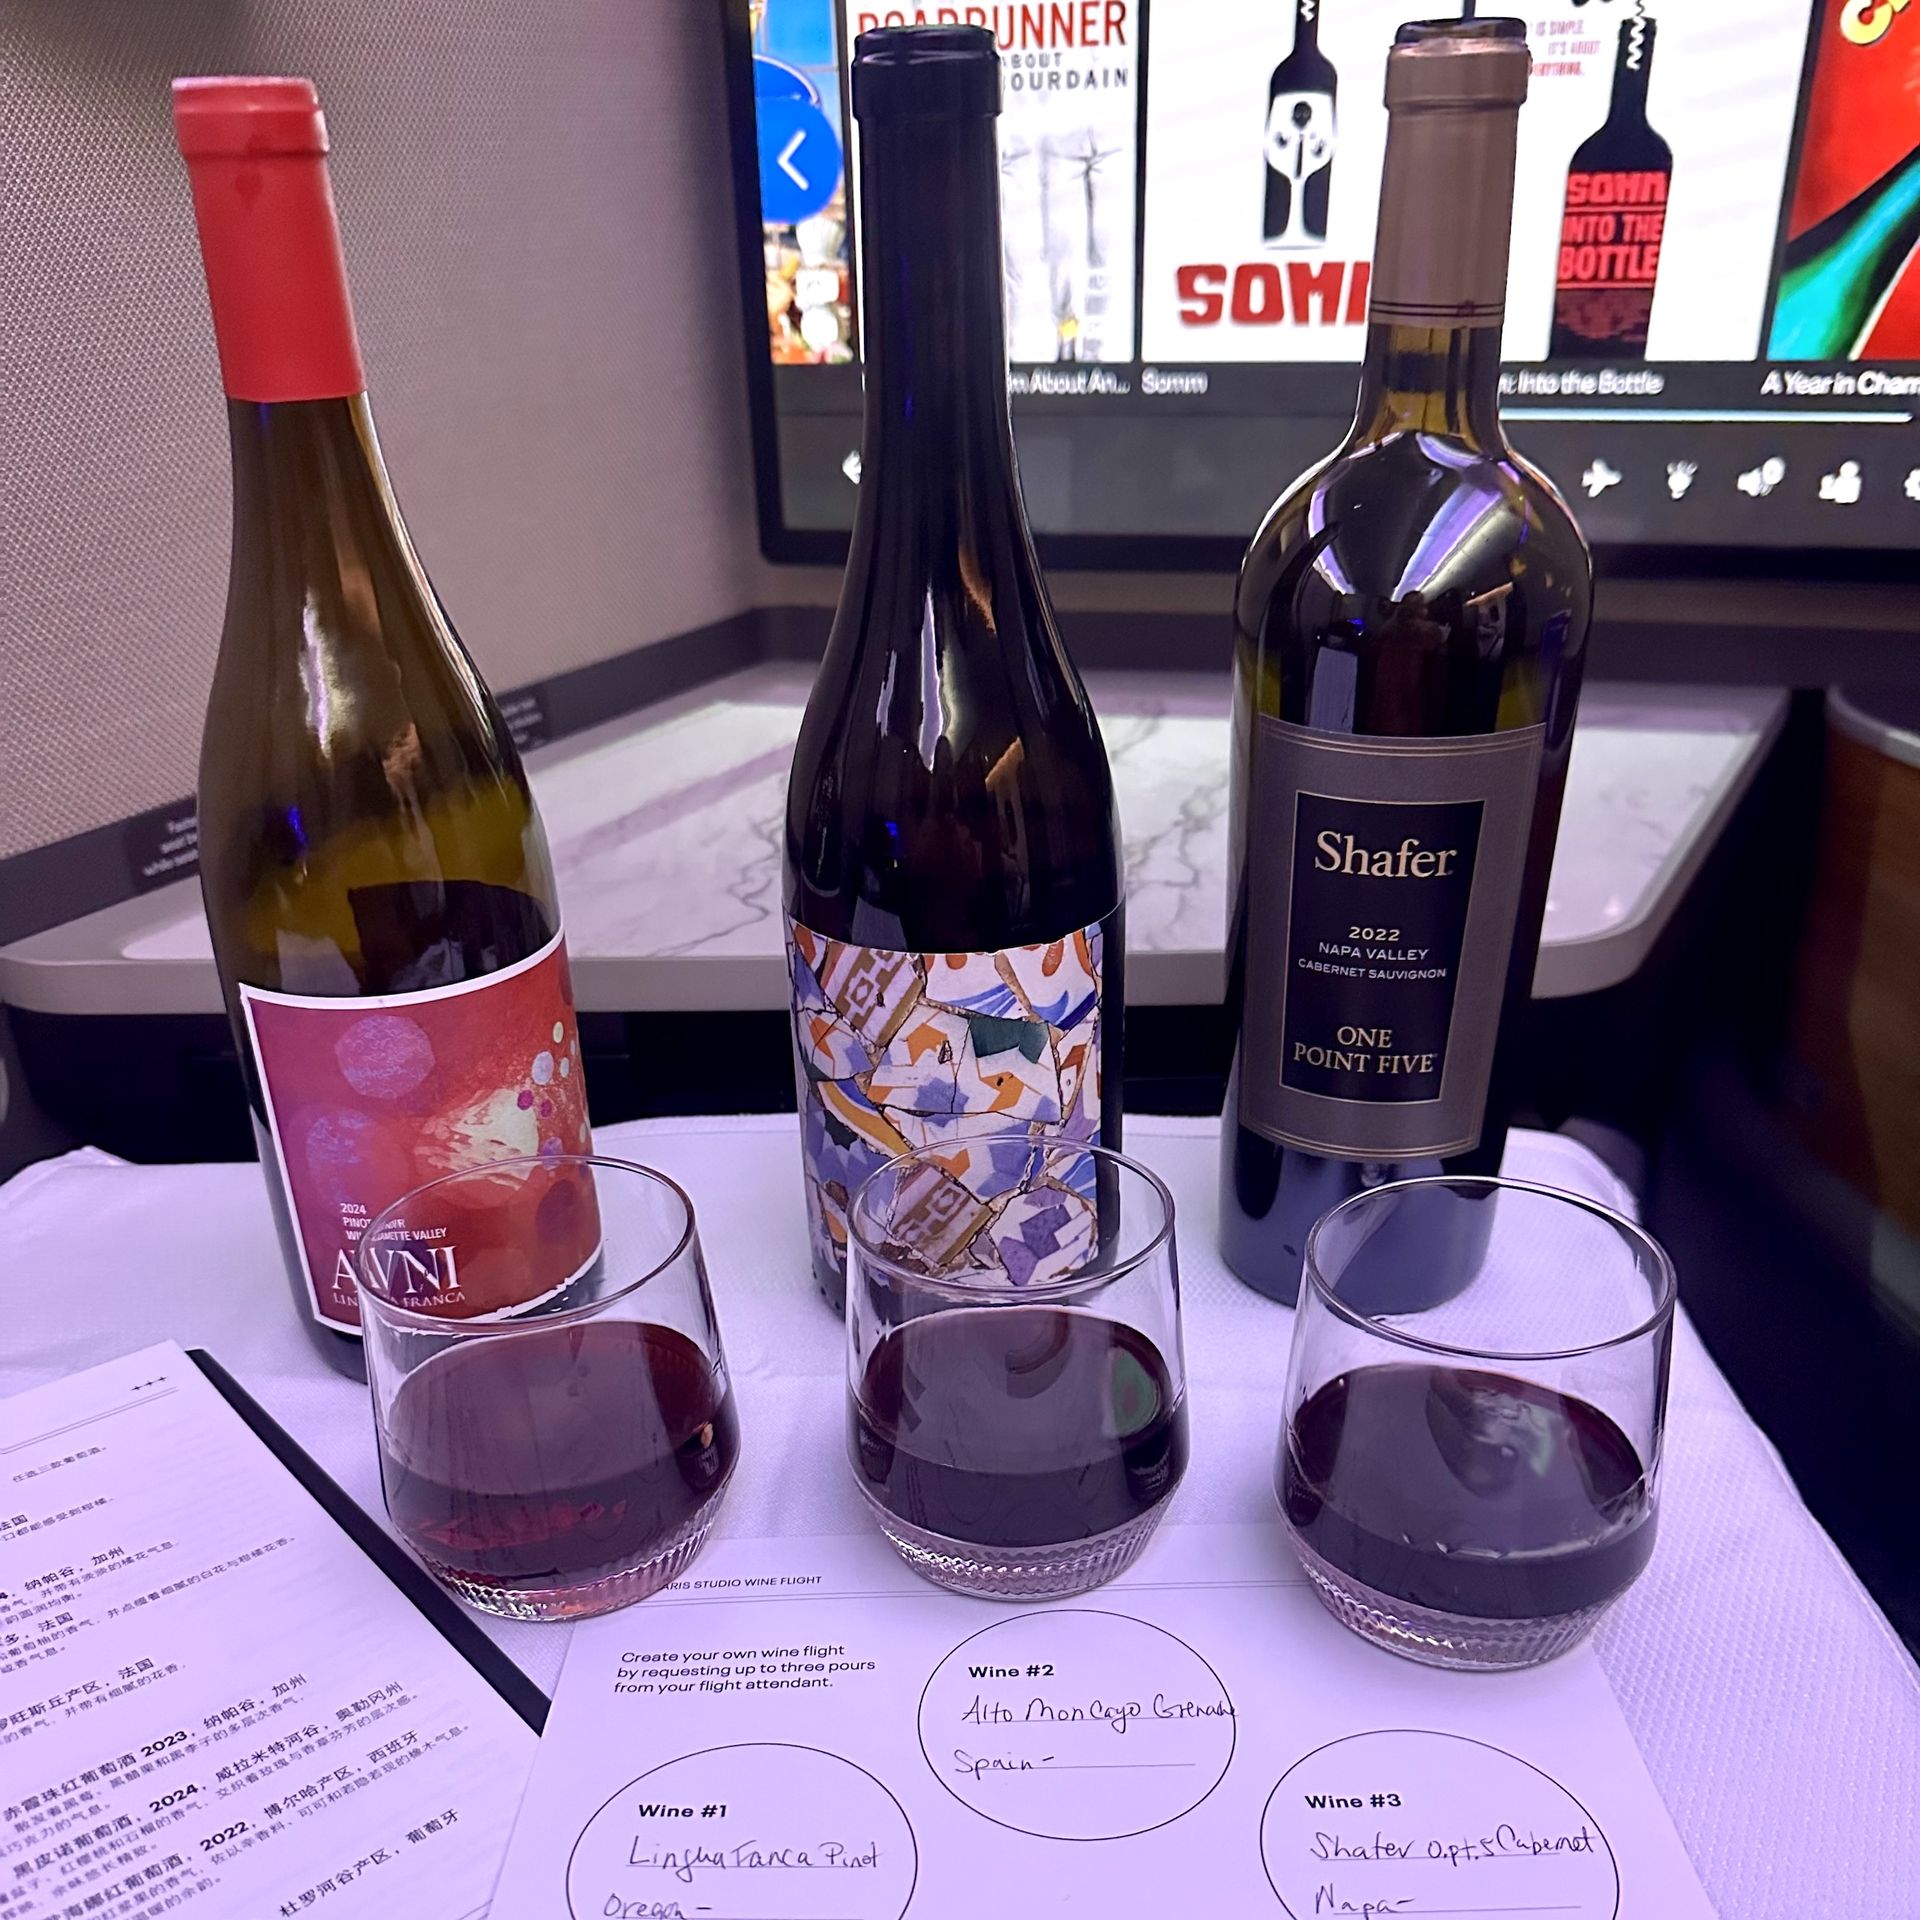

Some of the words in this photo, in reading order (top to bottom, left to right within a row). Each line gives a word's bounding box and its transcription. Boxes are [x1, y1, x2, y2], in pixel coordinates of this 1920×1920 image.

[1003, 68, 1129, 92] OURDAIN
[1562, 214, 1616, 243] INTO
[1622, 213, 1665, 243] THE
[1558, 244, 1660, 281] BOTTLE
[1030, 367, 1087, 395] About
[1141, 367, 1208, 395] Somm
[1518, 369, 1561, 395] Into
[1561, 369, 1598, 395] the
[1598, 368, 1665, 395] Bottle
[1761, 370, 1783, 395] A
[1784, 370, 1834, 395] Year
[1833, 371, 1855, 395] in
[1315, 831, 1458, 878] Shafer
[1348, 926, 1400, 942] 2022
[1318, 942, 1361, 959] NAPA
[1365, 947, 1429, 961] VALLEY
[1298, 958, 1366, 979] CABERNET
[1368, 968, 1447, 980] SAUVIGNON
[1337, 1026, 1392, 1049] ONE
[1293, 1042, 1370, 1073] POINT
[1377, 1053, 1434, 1074] FIVE
[340, 1203, 367, 1215] 2024
[412, 1227, 448, 1240] VALLEY
[332, 1245, 462, 1294] AVNI
[403, 1291, 466, 1308] FRANCA
[662, 1580, 691, 1591] ARIS
[693, 1578, 742, 1589] STUDIO
[744, 1576, 777, 1587] WINE
[779, 1576, 822, 1587] FLIGHT
[621, 1652, 679, 1664] Create
[682, 1650, 720, 1663] your
[722, 1649, 757, 1660] own
[761, 1648, 800, 1658] wine
[803, 1645, 845, 1660] flight
[617, 1665, 636, 1680] by
[641, 1663, 732, 1678] requesting
[734, 1664, 757, 1676] up
[759, 1662, 777, 1673] to
[780, 1660, 826, 1672] three
[828, 1660, 877, 1674] pours
[968, 1666, 1020, 1678] Wine
[1026, 1664, 1055, 1677] #2
[613, 1681, 654, 1694] from
[657, 1681, 696, 1695] your
[699, 1677, 743, 1693] flight
[745, 1676, 834, 1690] attendant.
[961, 1694, 1014, 1725] Alto
[4, 1752, 137, 1823] 赤霞珠红葡萄酒
[638, 1805, 694, 1818] Wine
[701, 1804, 728, 1818] #1
[1304, 1794, 1364, 1809] Wine
[1370, 1793, 1402, 1808] #3
[0, 1803, 111, 1859] 巧克力的气息。
[1496, 1823, 1598, 1856] Cabernet
[818, 1840, 881, 1869] Pinot
